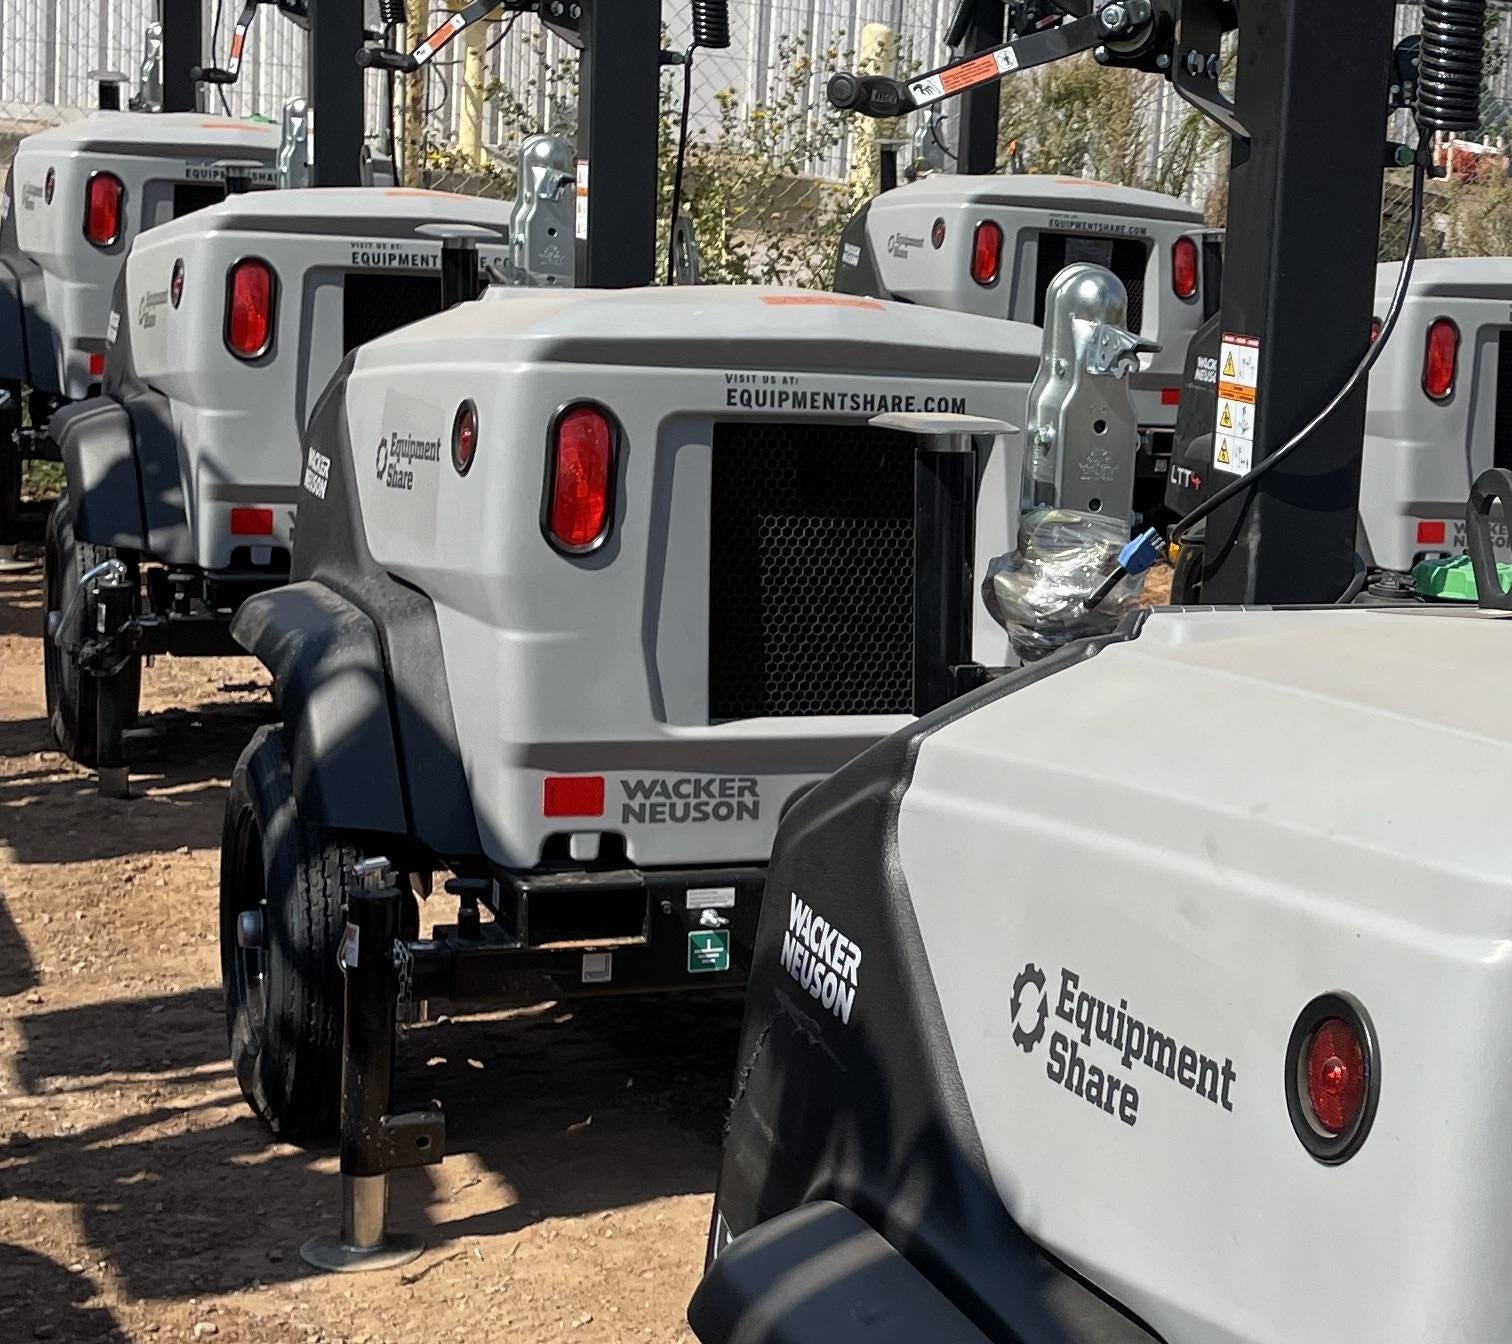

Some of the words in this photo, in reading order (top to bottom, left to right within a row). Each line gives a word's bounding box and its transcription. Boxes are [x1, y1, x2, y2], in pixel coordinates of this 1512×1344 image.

[725, 373, 757, 385] VISIT
[762, 375, 777, 385] US
[726, 388, 967, 415] EQUIPMENTSHARE.COM
[389, 431, 441, 465] Equipment
[386, 462, 414, 491] Share
[1170, 464, 1202, 491] LTT4
[620, 777, 760, 801] WACKER
[621, 800, 760, 825] NEUSON
[789, 891, 862, 987] WACKER
[780, 929, 856, 1025] NEUSON
[1055, 967, 1237, 1113] Equipment
[1046, 1030, 1139, 1127] Share
